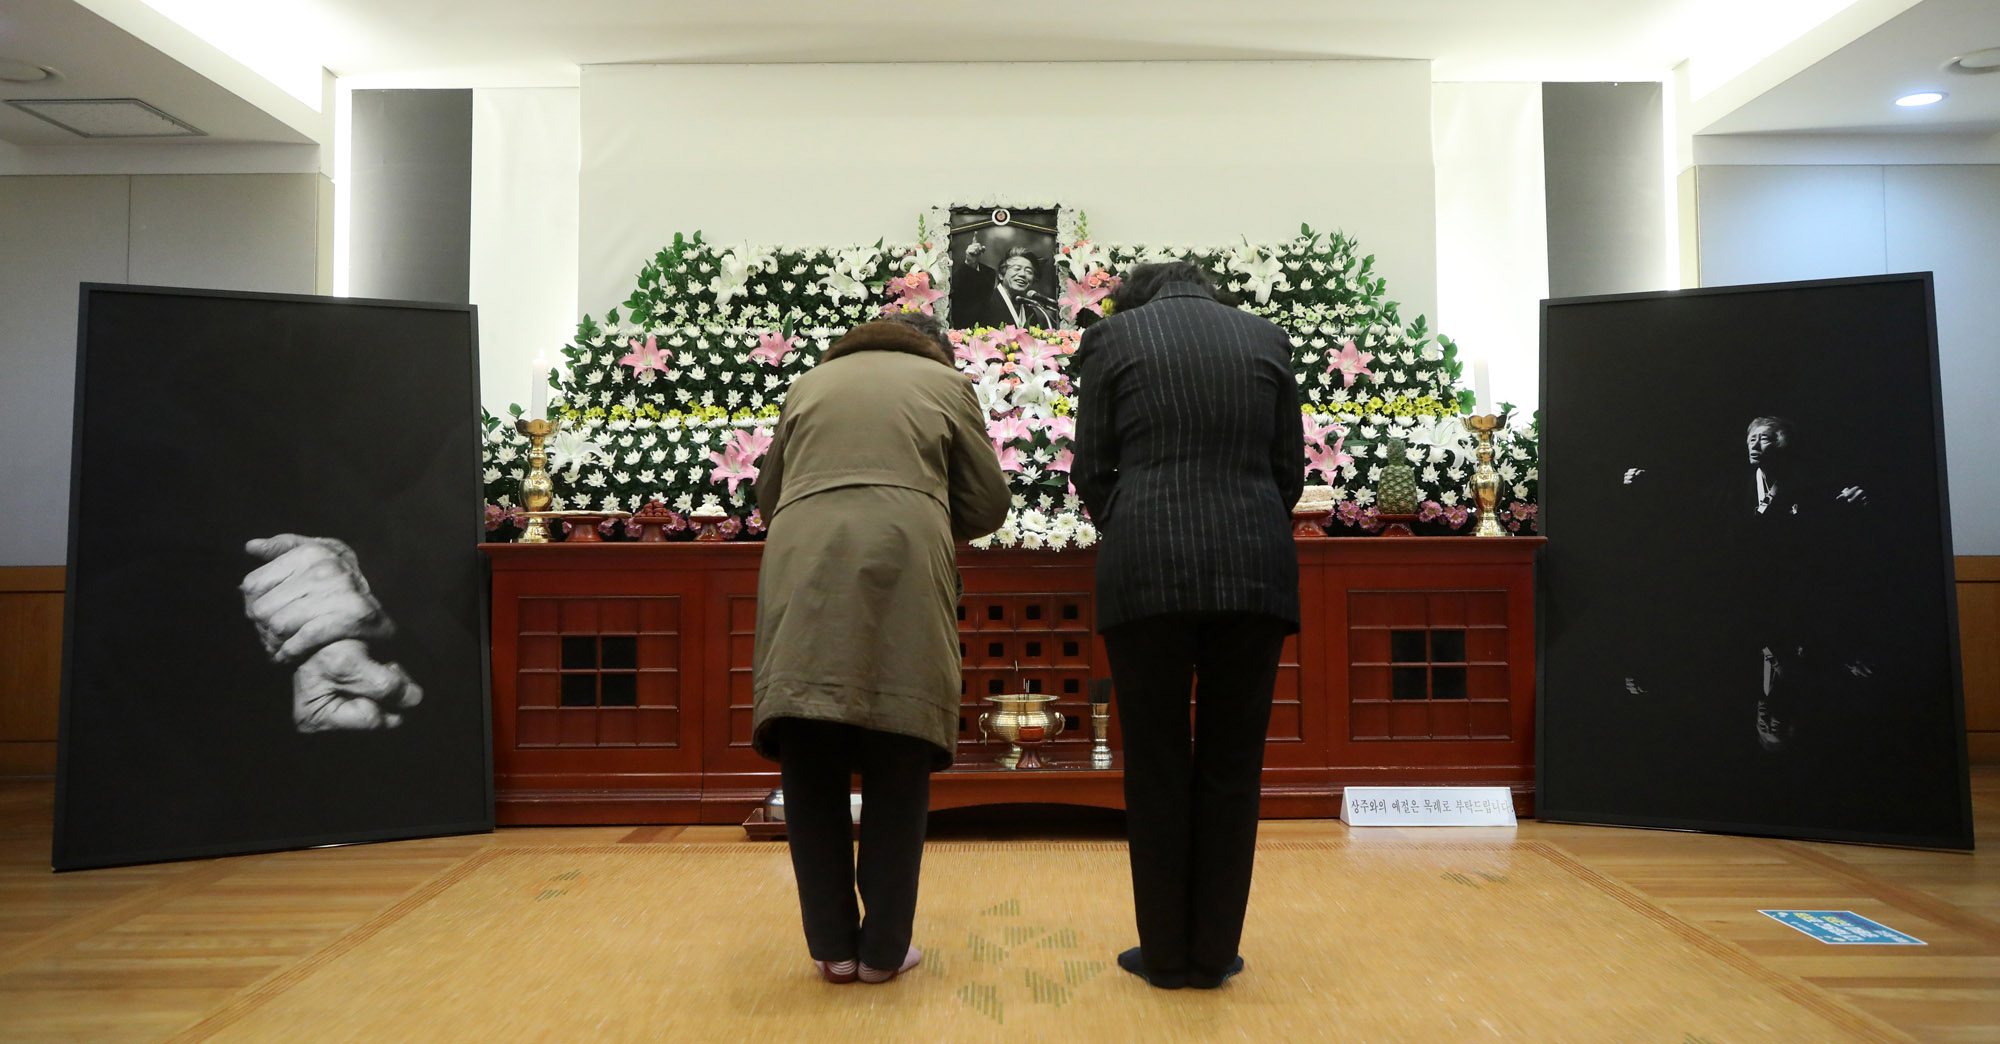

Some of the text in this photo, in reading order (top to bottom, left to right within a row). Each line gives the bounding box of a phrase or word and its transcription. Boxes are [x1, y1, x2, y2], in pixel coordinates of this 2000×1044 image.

[1350, 799, 1387, 814] 상주와의
[1392, 799, 1420, 814] 예절은
[1423, 799, 1452, 814] 목례로
